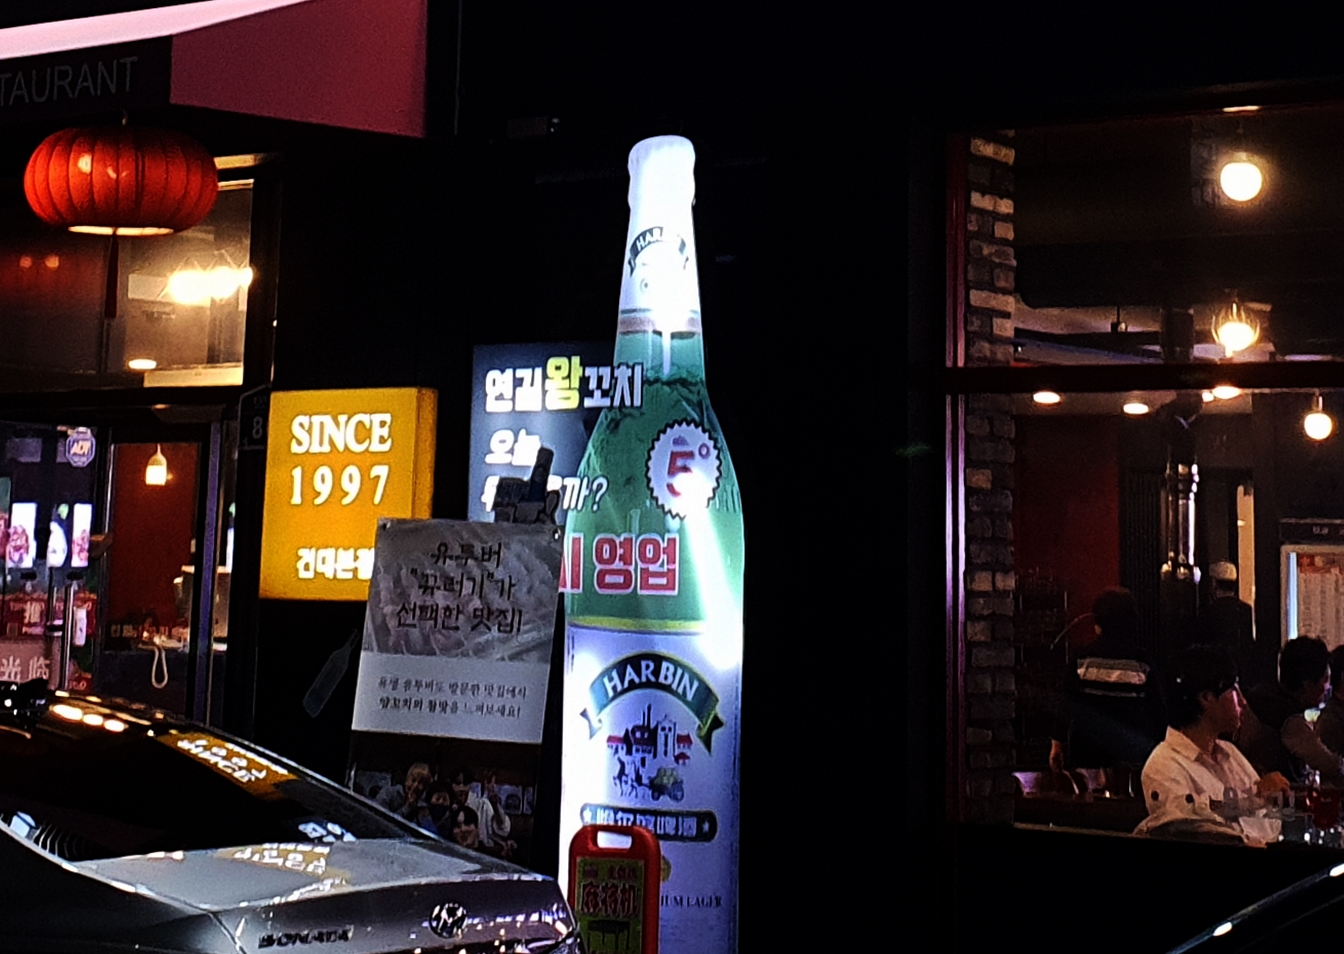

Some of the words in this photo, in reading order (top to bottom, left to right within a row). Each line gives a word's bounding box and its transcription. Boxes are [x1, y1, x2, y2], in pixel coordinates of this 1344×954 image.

[485, 356, 643, 412] 연길왕꼬치
[290, 412, 392, 454] SINCE
[291, 464, 389, 506] 1997
[430, 541, 502, 568] 유투버
[593, 533, 680, 595] 영업
[396, 602, 463, 630] 선택한
[470, 607, 523, 634] 맛집!
[603, 660, 699, 701] HARBIN
